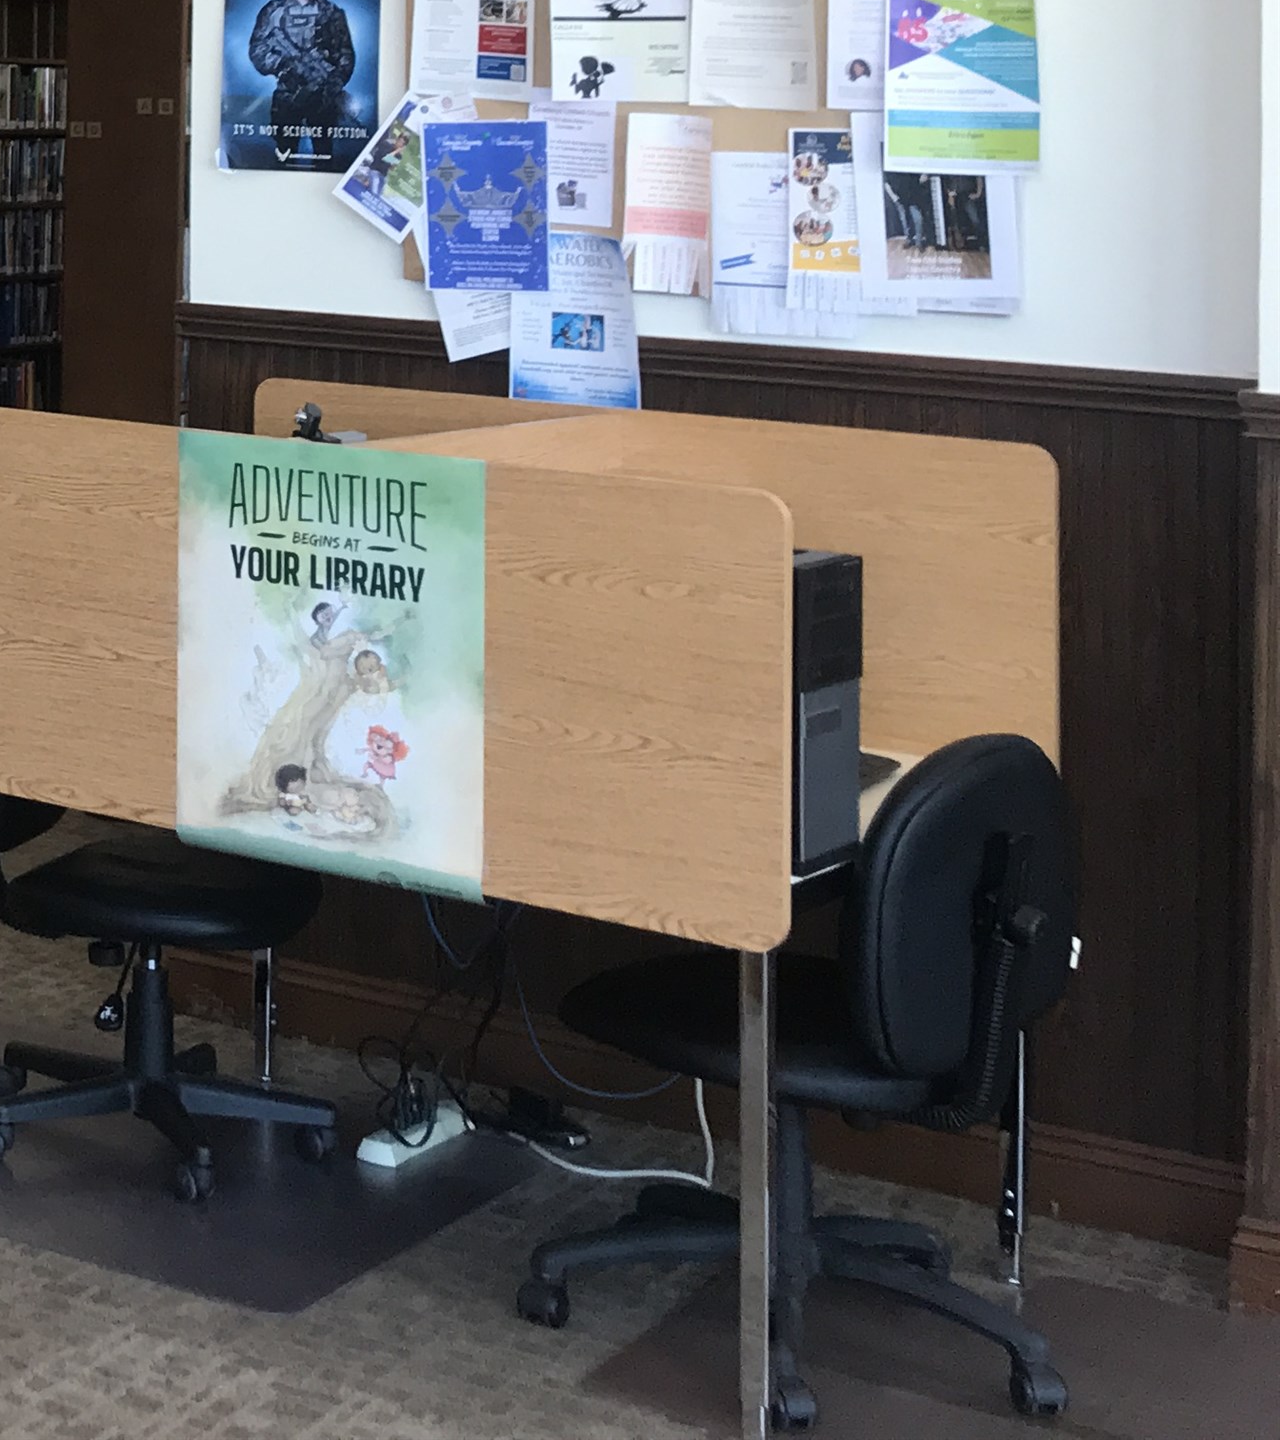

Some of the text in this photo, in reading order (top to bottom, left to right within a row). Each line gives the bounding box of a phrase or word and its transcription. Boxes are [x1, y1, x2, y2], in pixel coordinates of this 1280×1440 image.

[233, 124, 370, 139] IT'S NOT SCIENCE FICTION.
[228, 462, 428, 553] ADVENTURE
[292, 531, 362, 553] BEGINS AT
[230, 544, 425, 603] YOUR LIBRARY
